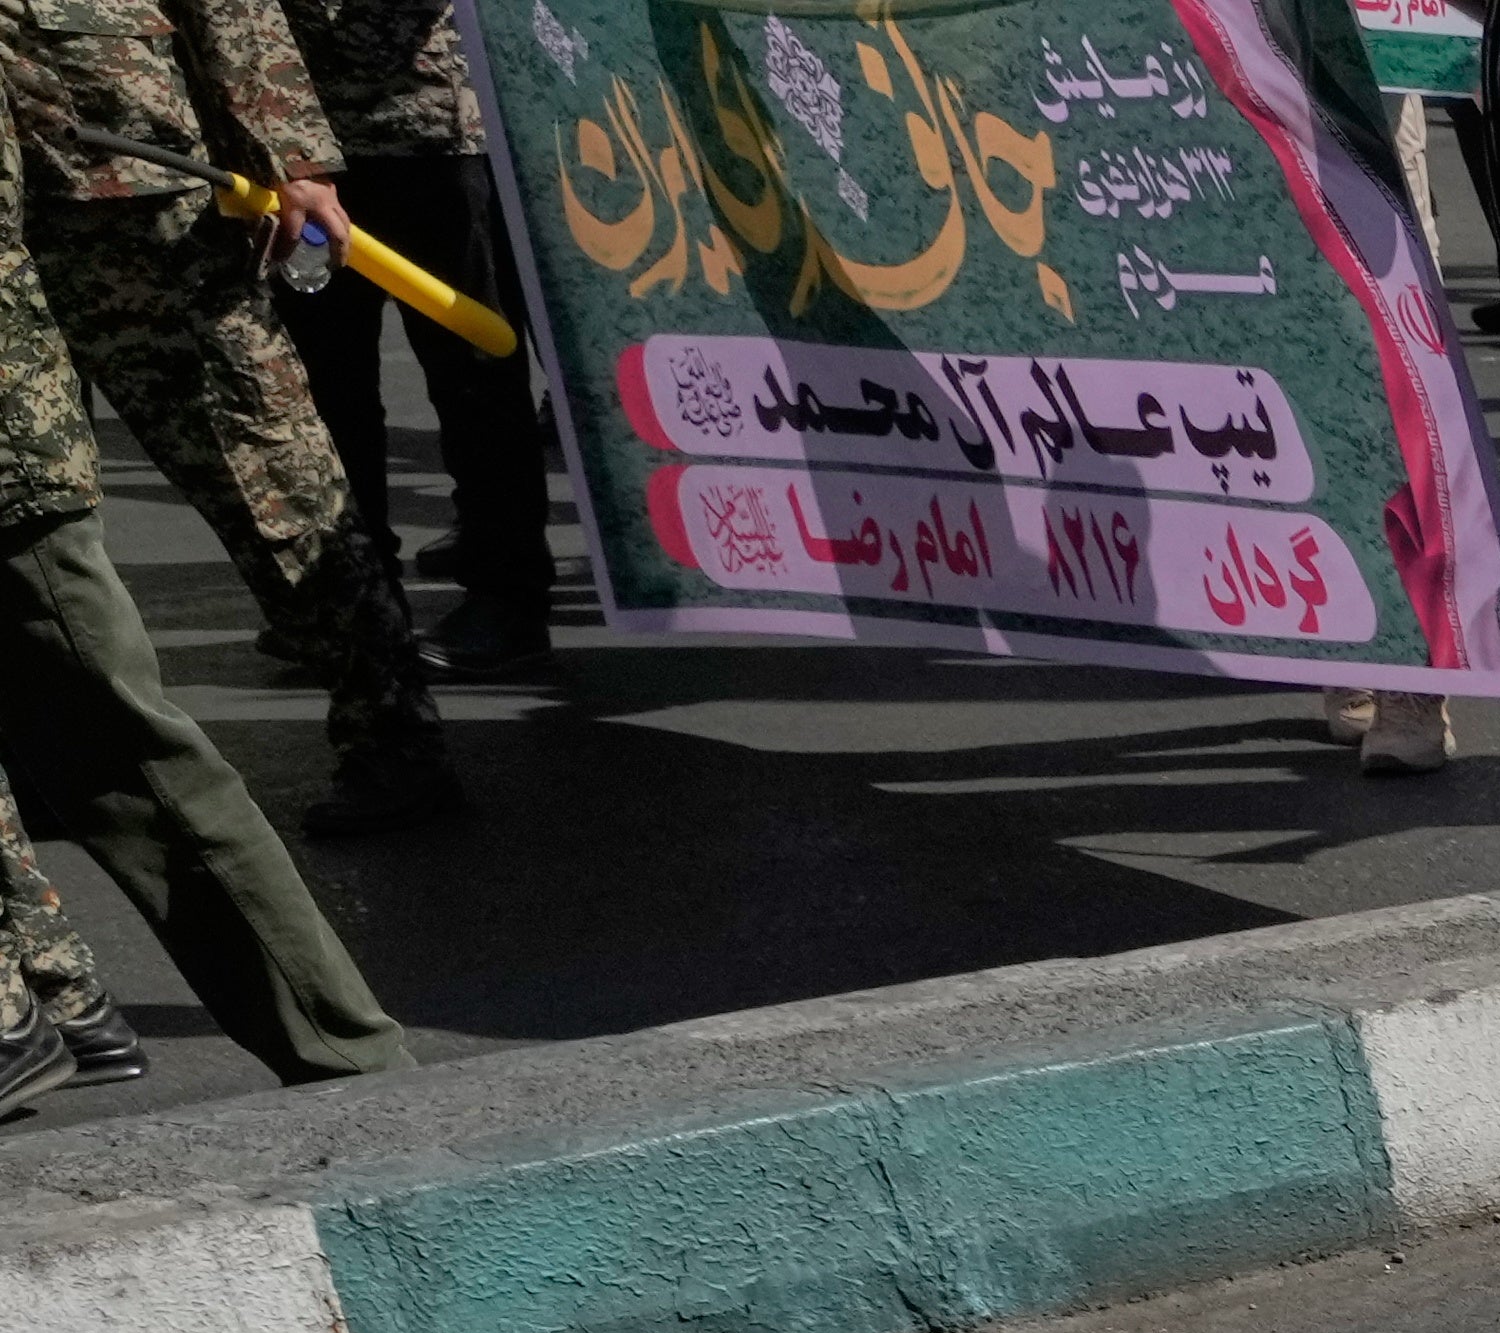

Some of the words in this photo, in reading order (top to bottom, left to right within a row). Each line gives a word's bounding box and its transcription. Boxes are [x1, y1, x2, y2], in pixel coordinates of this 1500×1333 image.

[1028, 34, 1207, 123] رزمایش
[1117, 244, 1277, 320] مردم
[753, 364, 939, 442] محمد
[940, 351, 1016, 470] آل
[1020, 356, 1175, 480] عالم
[1180, 369, 1277, 494] تیپ
[786, 482, 910, 593] رضا
[914, 495, 993, 600] امام
[1203, 522, 1328, 634] گردان
